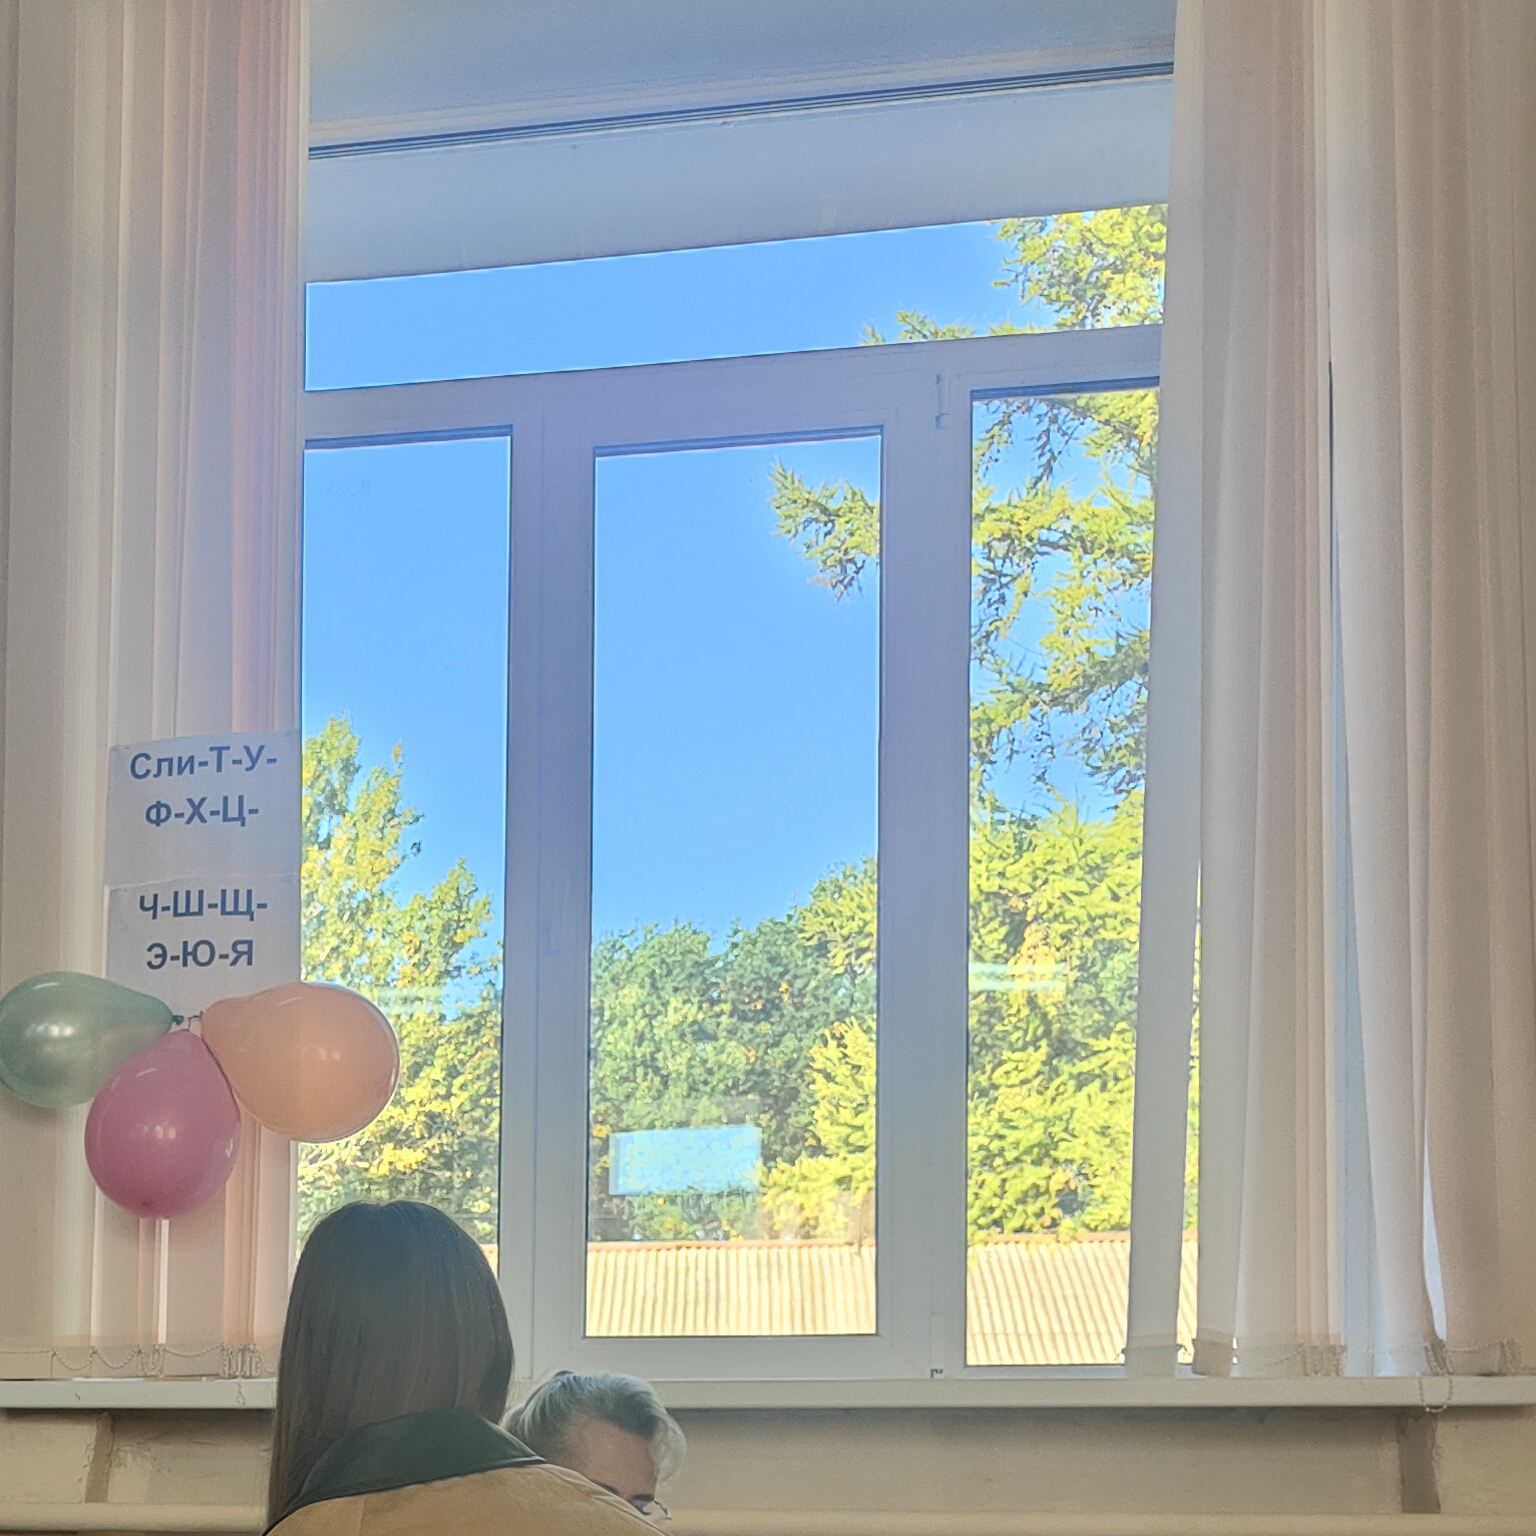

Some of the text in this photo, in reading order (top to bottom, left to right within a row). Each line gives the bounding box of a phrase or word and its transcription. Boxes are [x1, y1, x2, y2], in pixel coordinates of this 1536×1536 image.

[129, 745, 278, 780] Сли-Т-У-
[145, 795, 260, 828] Ф-Х-Ц-
[138, 888, 268, 922] Ч-Ш-Щ-
[146, 939, 254, 970] Э-Ю-Я
